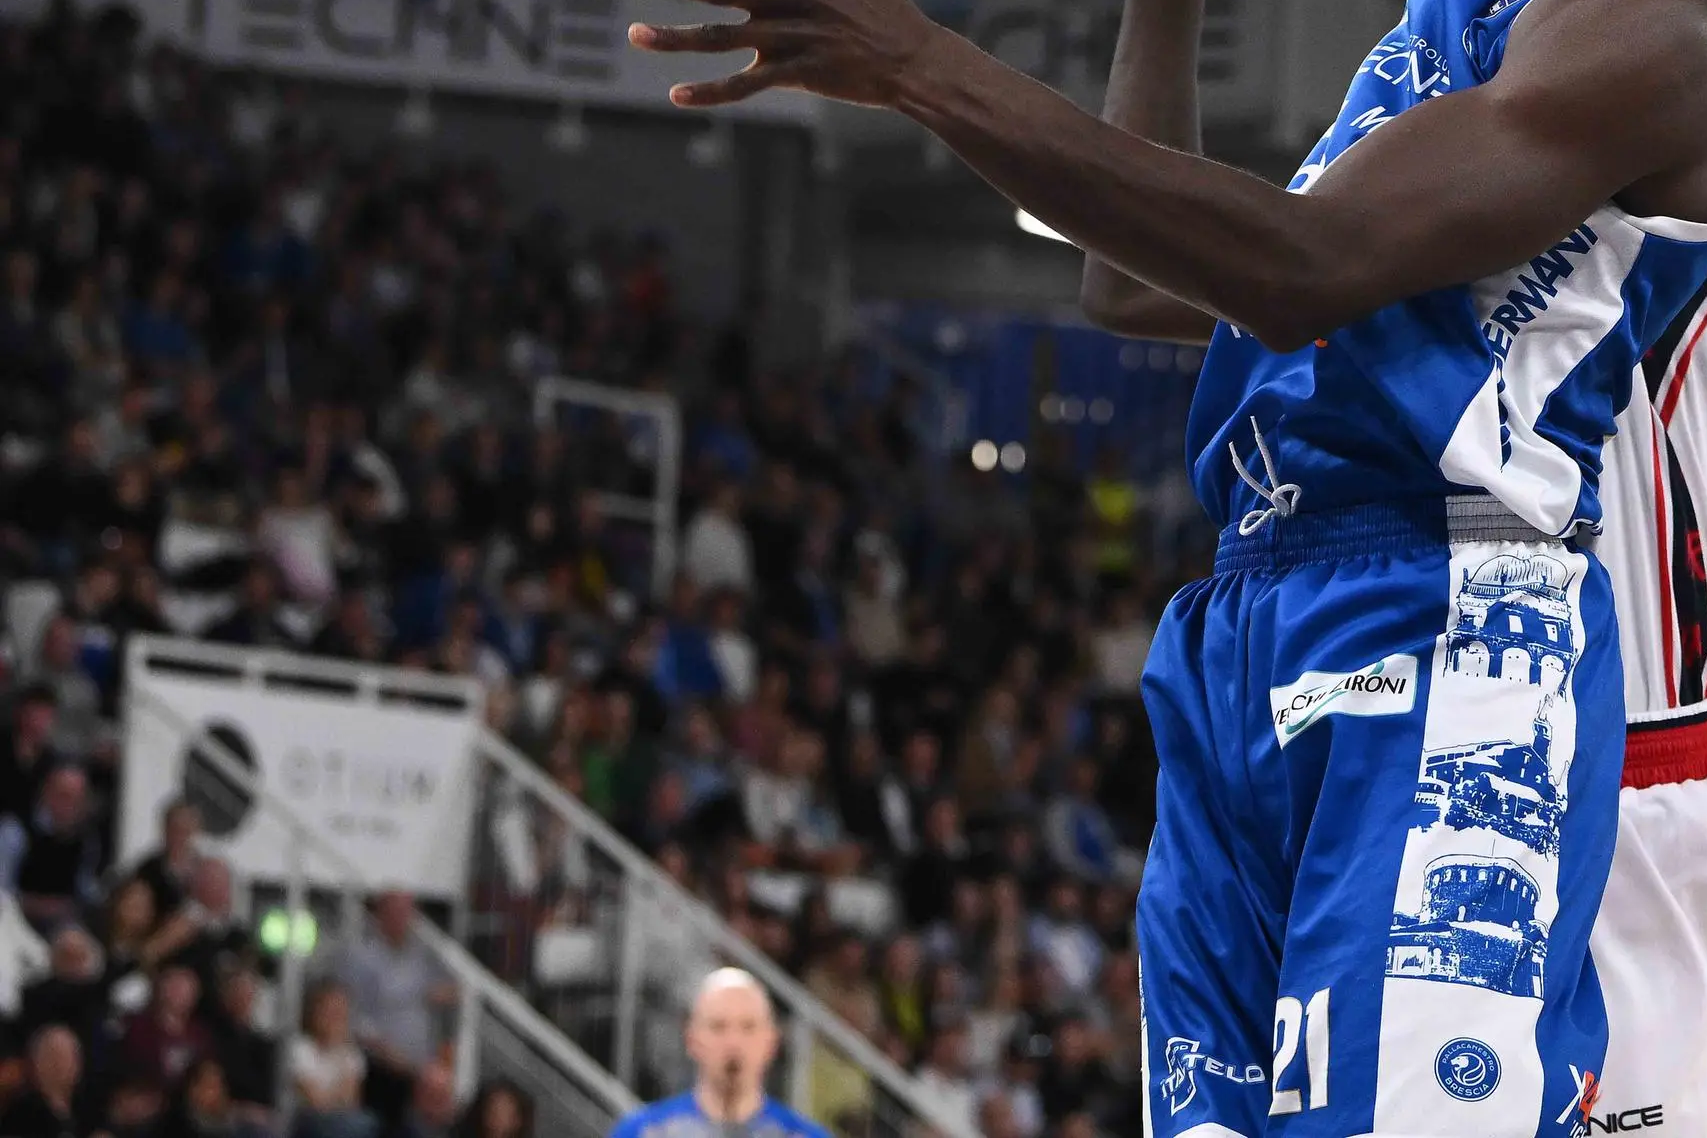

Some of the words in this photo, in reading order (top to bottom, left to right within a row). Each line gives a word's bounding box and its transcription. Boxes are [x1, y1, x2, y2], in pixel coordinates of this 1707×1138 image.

[1482, 222, 1599, 364] ERMANI
[1268, 986, 1331, 1117] 21
[1441, 1043, 1495, 1072] PALLACANESTRO
[1445, 1076, 1490, 1097] BRESCIA
